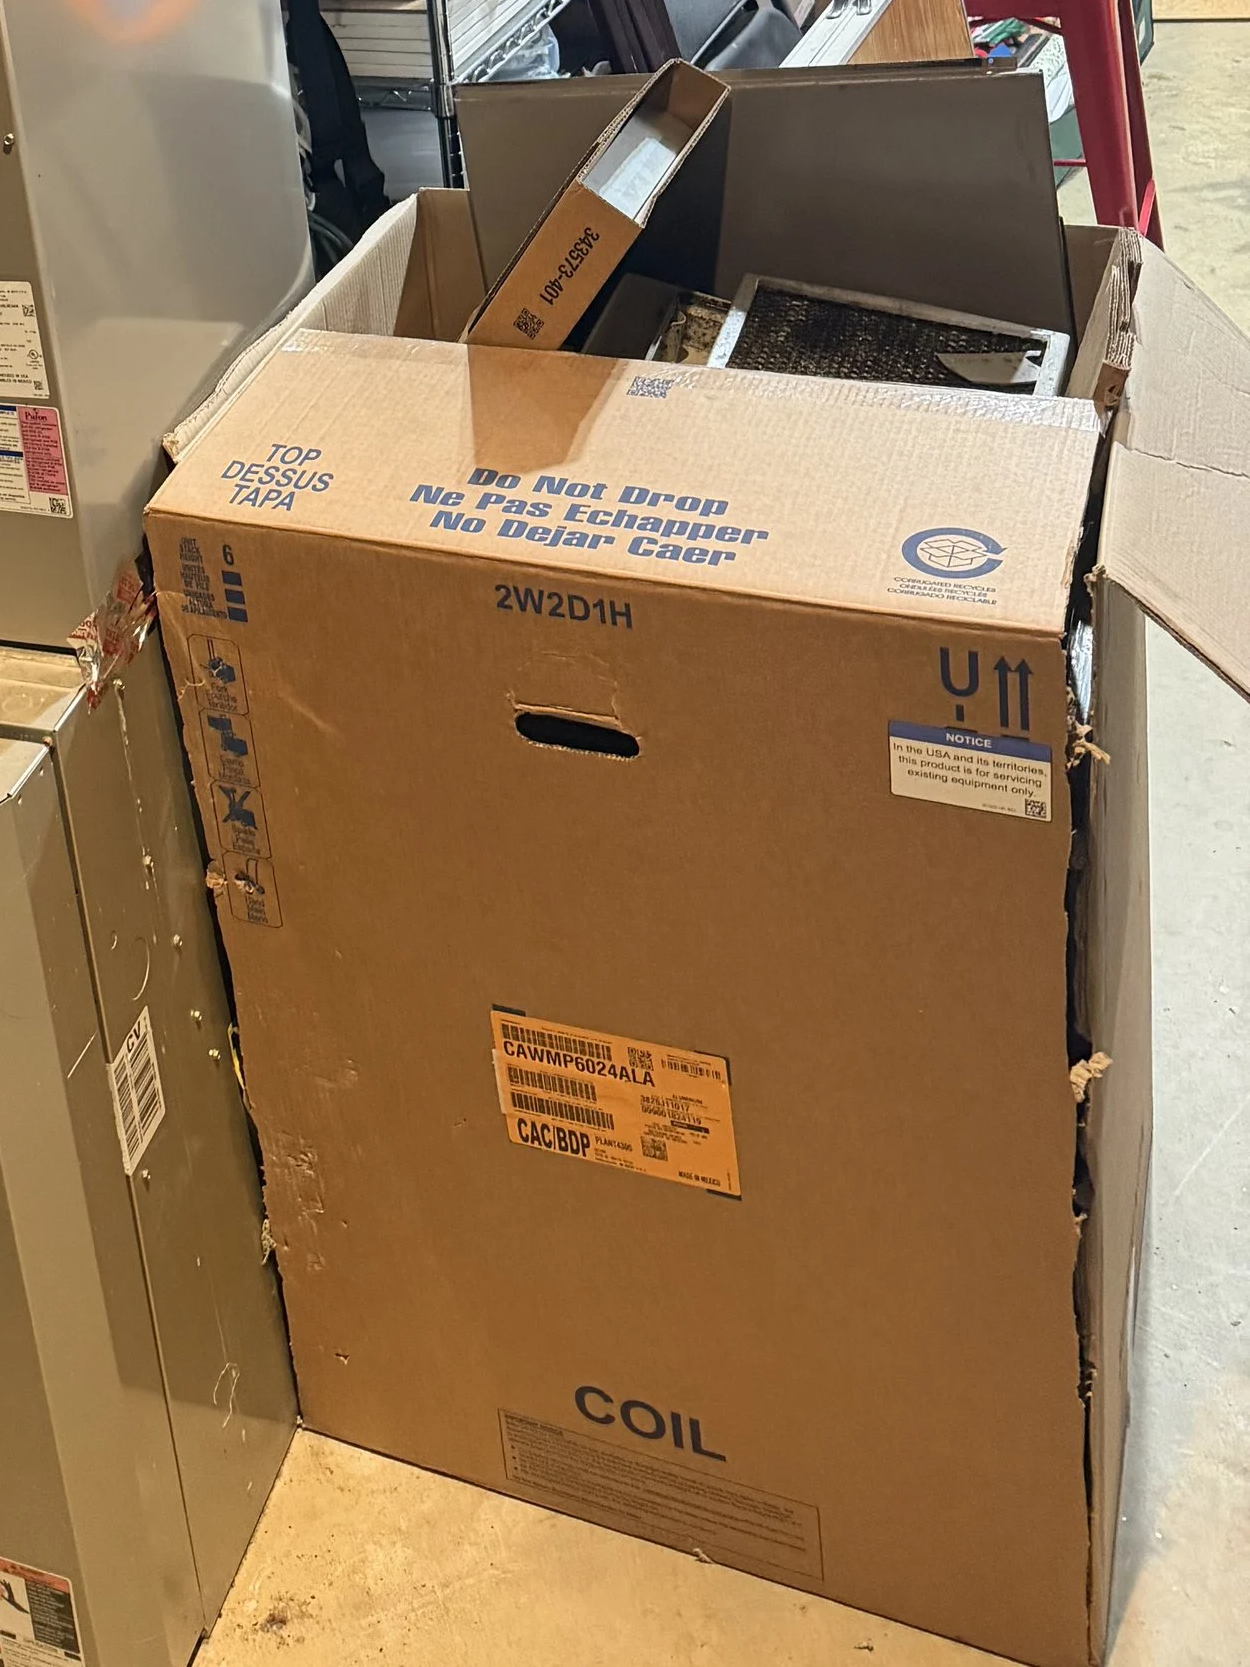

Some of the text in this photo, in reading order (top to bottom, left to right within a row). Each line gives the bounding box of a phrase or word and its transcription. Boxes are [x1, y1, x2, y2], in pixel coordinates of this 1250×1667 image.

[540, 226, 600, 306] 343573-401
[266, 444, 321, 466] TOP
[221, 460, 334, 492] DESSUS
[468, 468, 729, 517] Do Not Drop
[228, 484, 297, 511] TAPA
[410, 485, 769, 545] Ne Pas Echapper
[222, 544, 235, 566] 6
[430, 511, 737, 566] No Dejar Caer
[887, 588, 997, 605] CORRUGADO RECICLABLE
[894, 577, 951, 588] CORRUGATED
[494, 584, 633, 628] 2W2D1H
[945, 733, 992, 748] NOTICE
[893, 742, 1047, 777] In the USA and its territories,
[898, 755, 1042, 788] this product is for servicing
[907, 769, 1035, 798] existing equipment only.
[503, 1040, 655, 1087] CAWMP6024ALA
[517, 1117, 590, 1157] CAC/BDP
[575, 1386, 727, 1463] COIL
